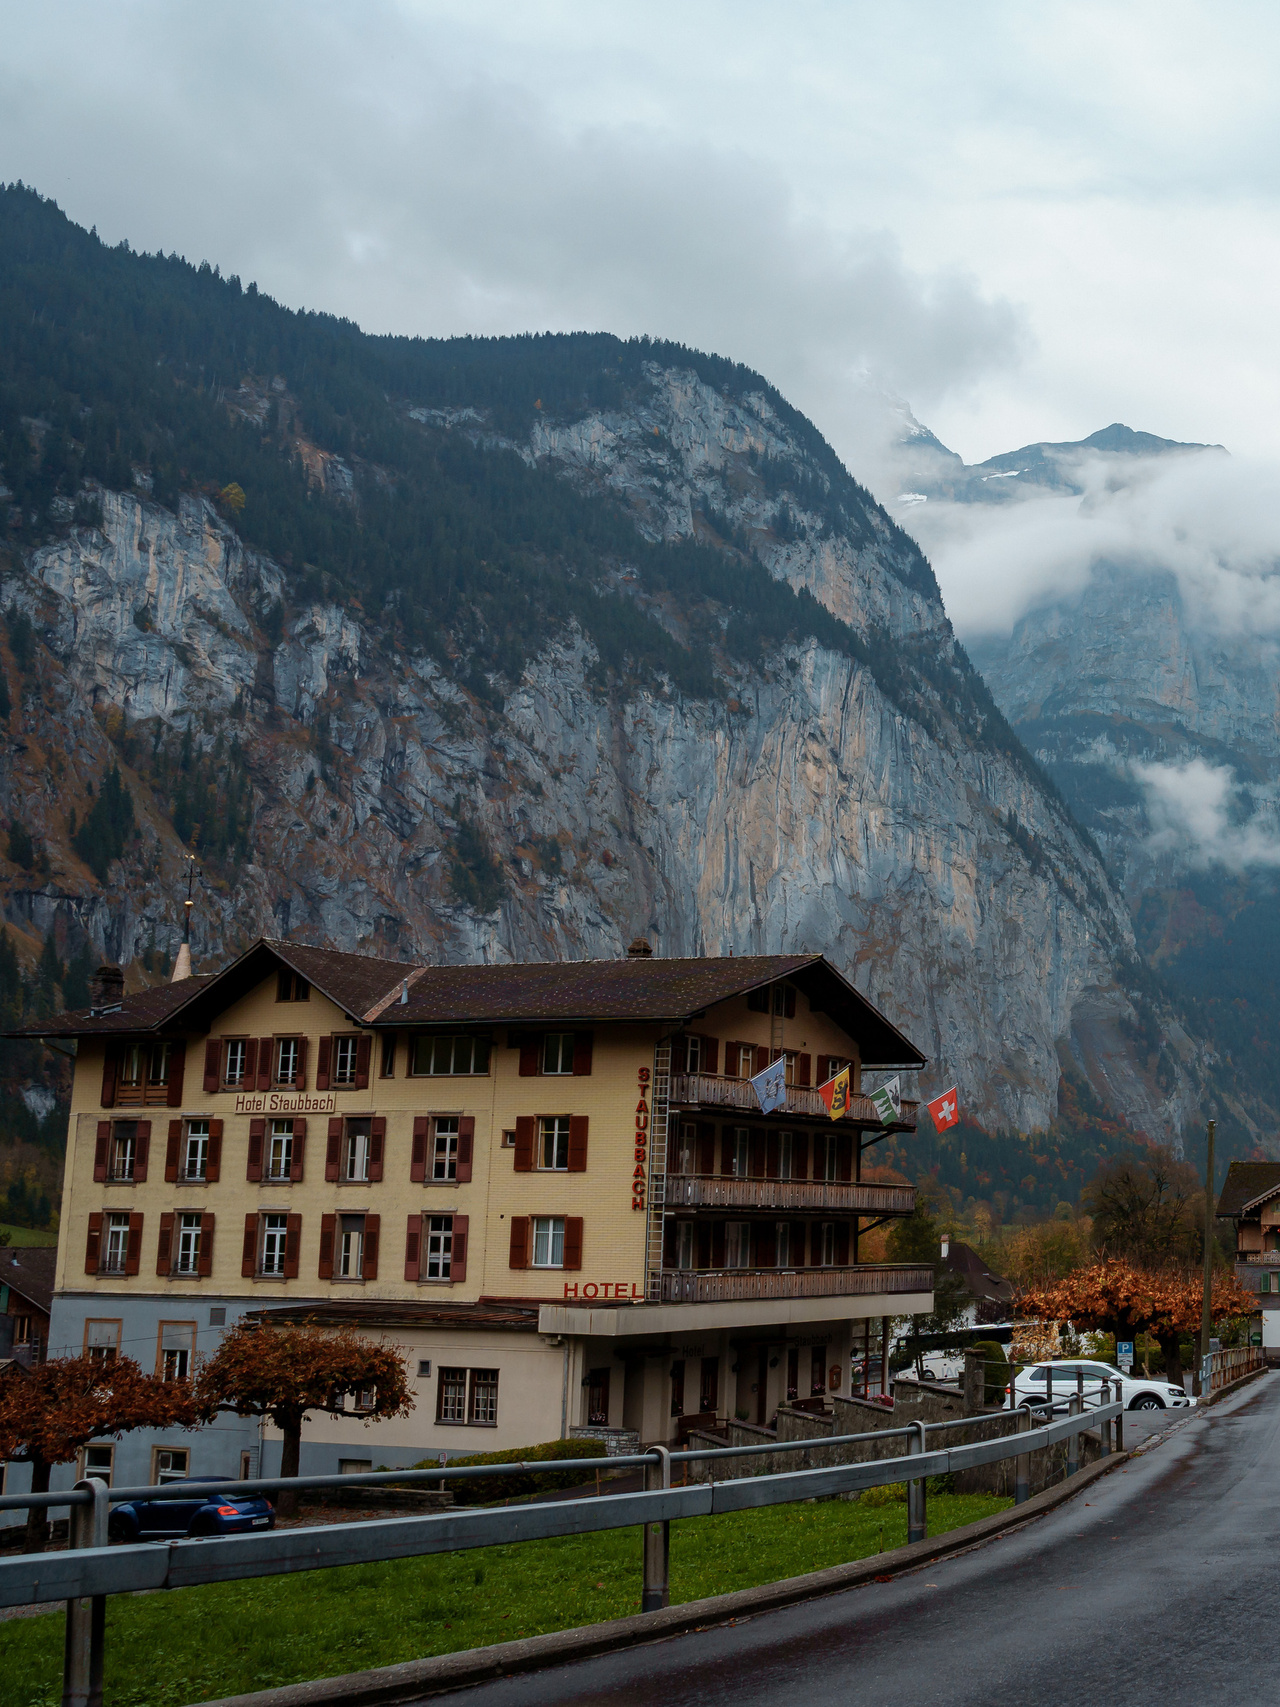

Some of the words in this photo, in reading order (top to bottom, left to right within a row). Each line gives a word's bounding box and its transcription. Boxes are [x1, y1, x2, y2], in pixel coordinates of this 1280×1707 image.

[235, 1094, 267, 1111] Hotel
[269, 1094, 334, 1111] Staubbach
[632, 1067, 650, 1210] STAUBBACH
[564, 1282, 645, 1299] HOTEL
[682, 1343, 705, 1358] Hotel
[794, 1332, 833, 1348] Staubbach
[1122, 1343, 1129, 1353] P
